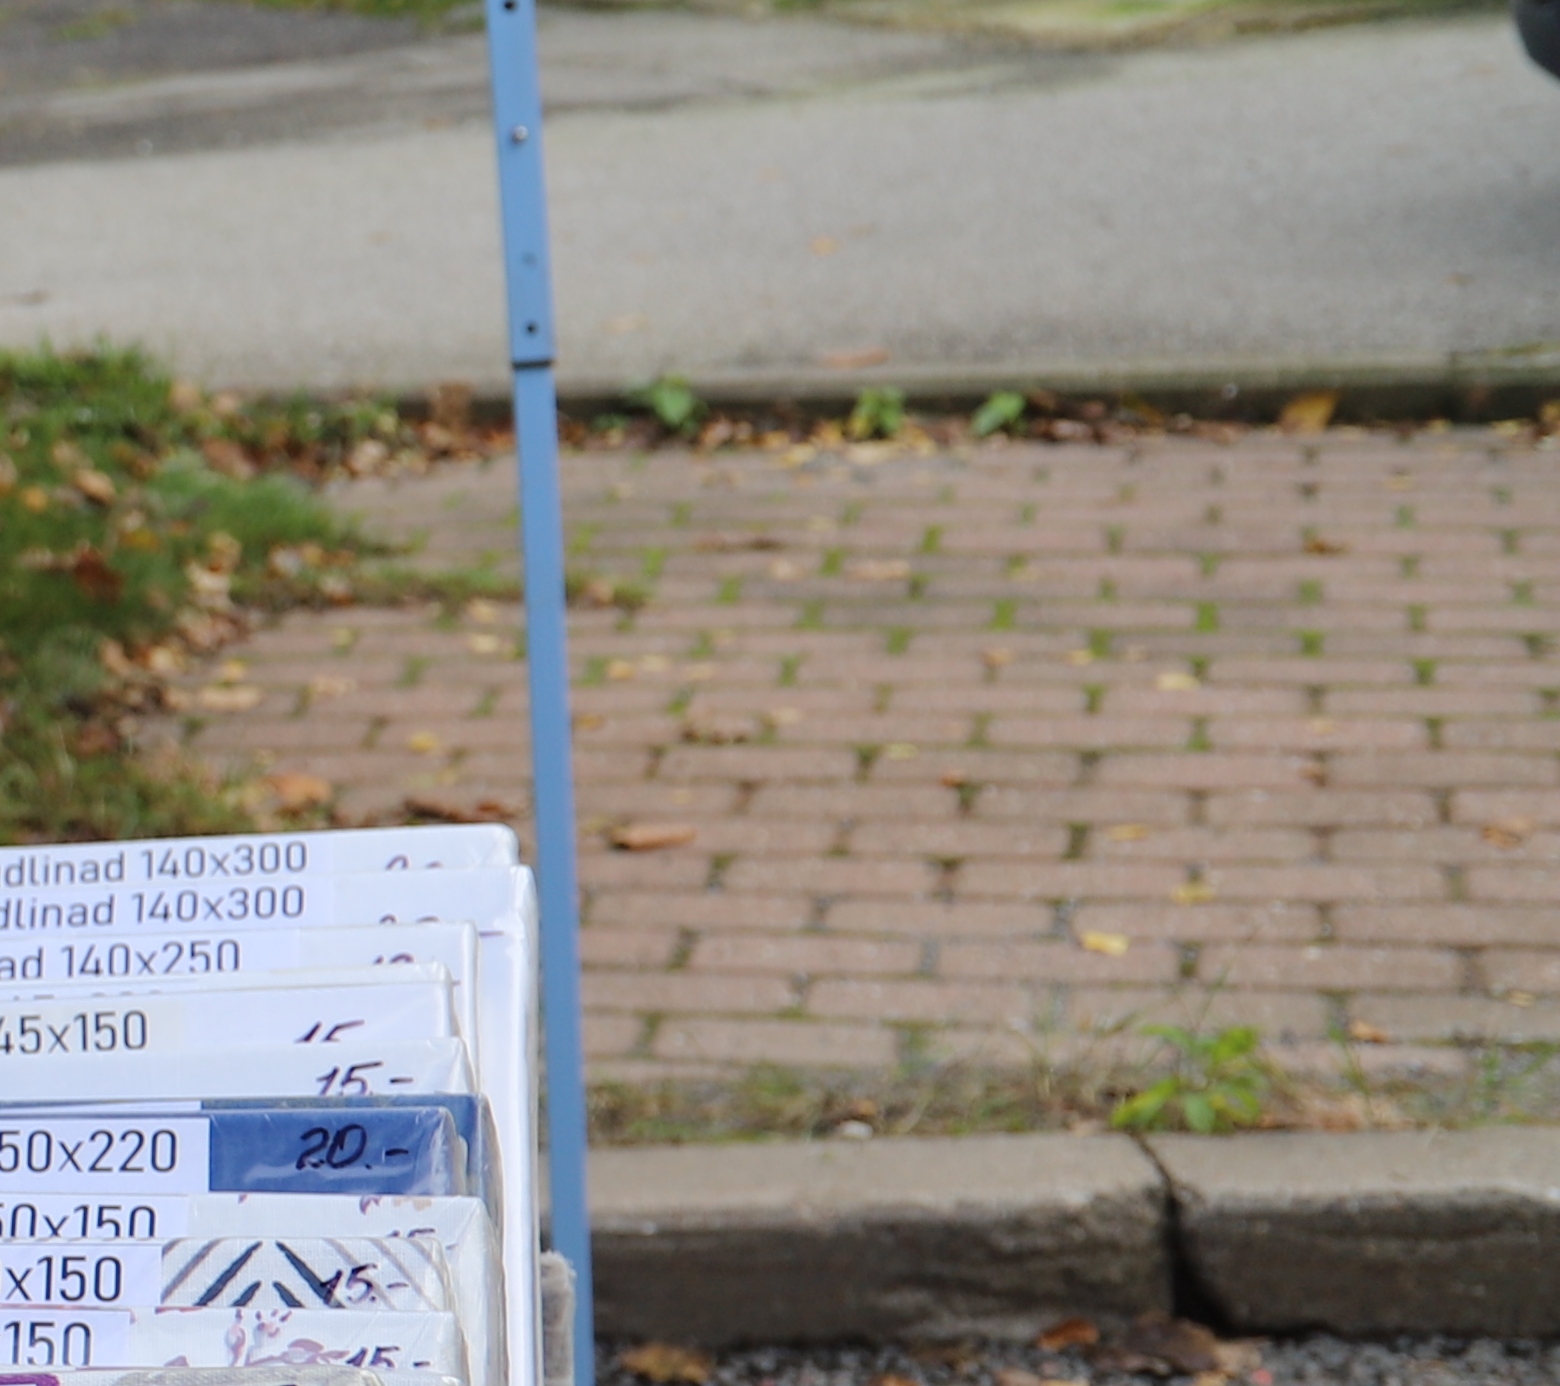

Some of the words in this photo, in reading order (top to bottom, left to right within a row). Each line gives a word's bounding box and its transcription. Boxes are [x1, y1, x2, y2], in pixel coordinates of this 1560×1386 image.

[140, 841, 308, 879] 140x300
[132, 885, 306, 925] 140x300
[60, 938, 241, 977] 140x250
